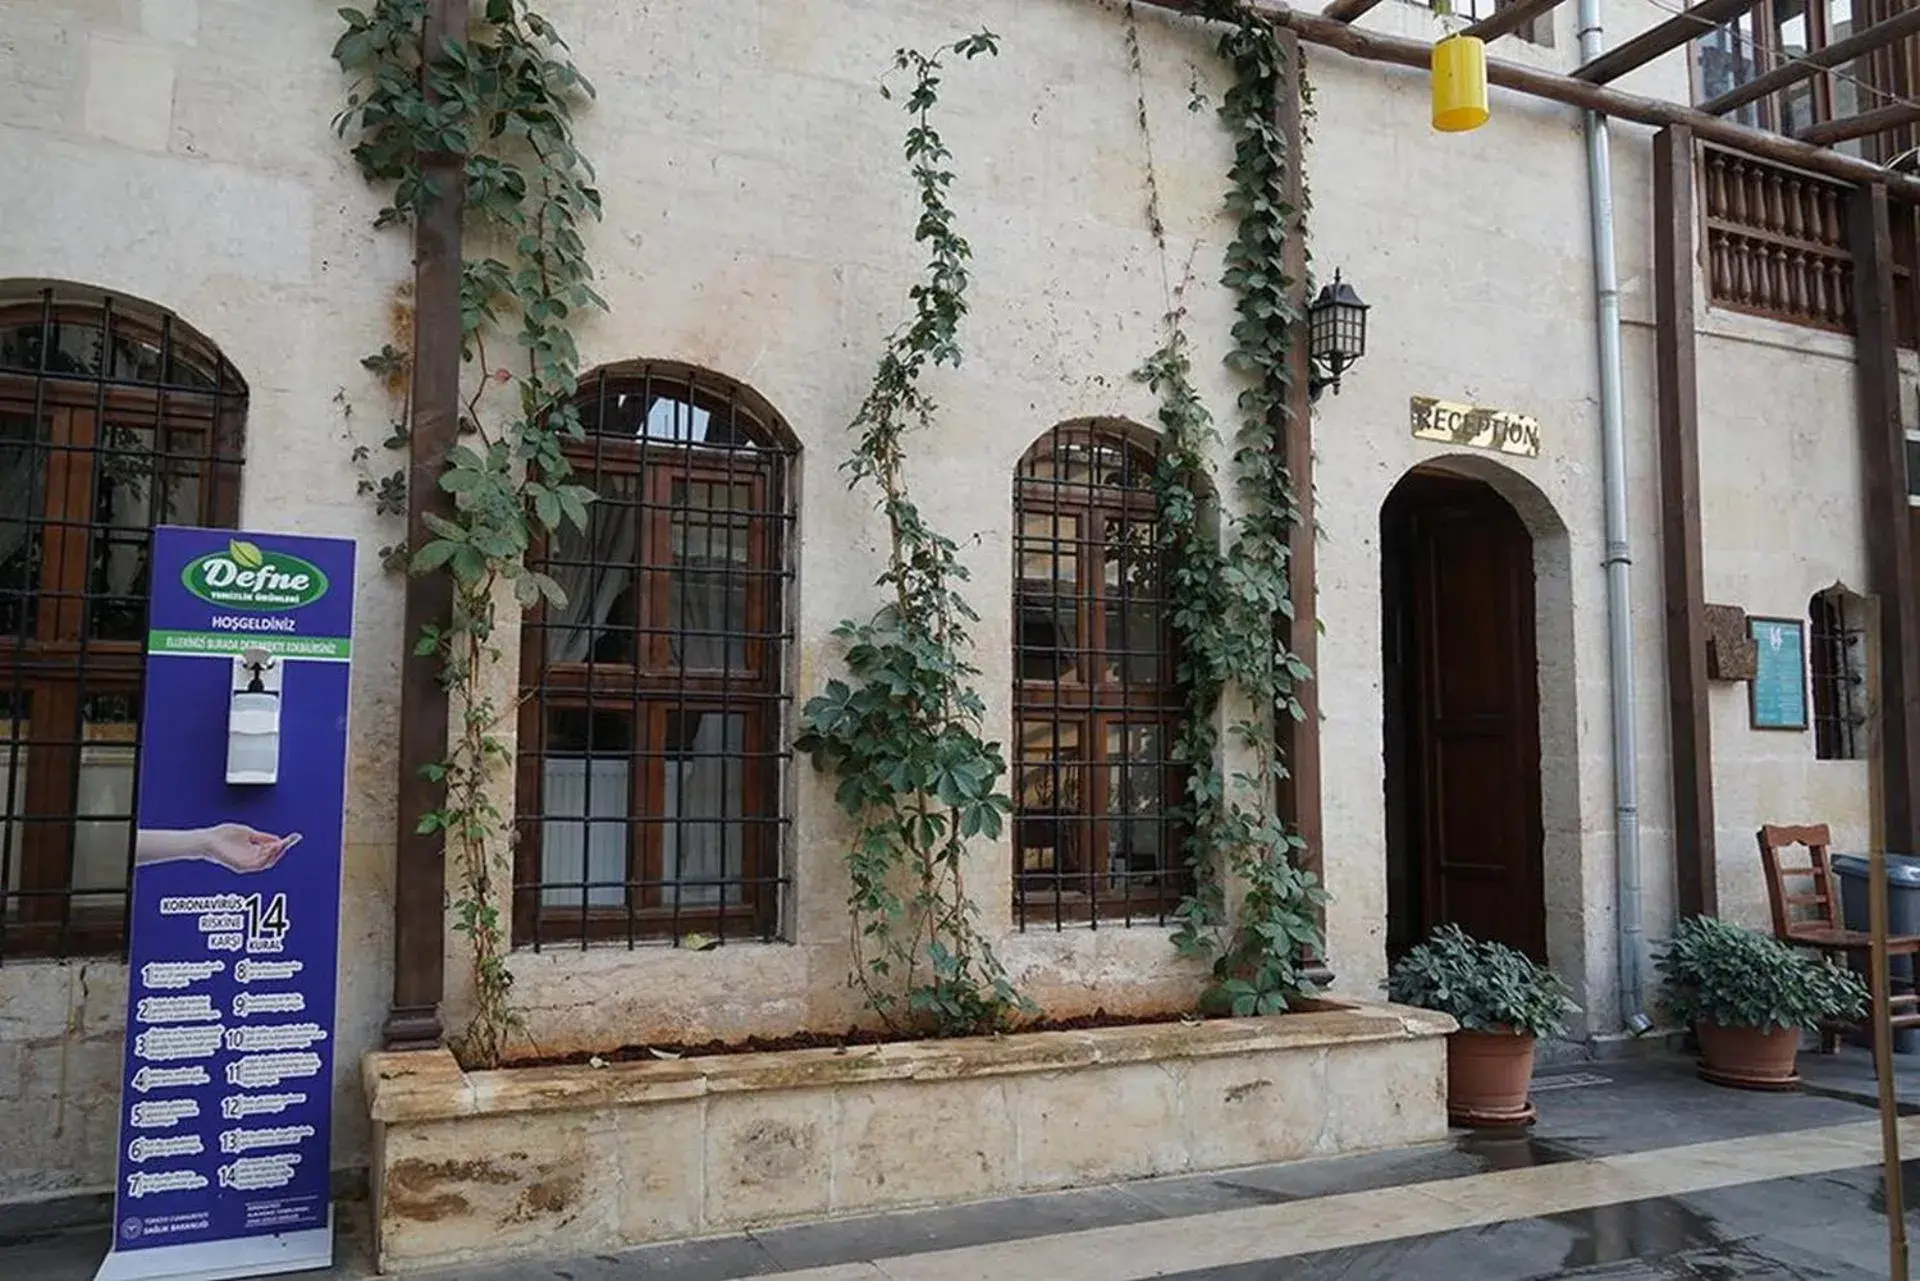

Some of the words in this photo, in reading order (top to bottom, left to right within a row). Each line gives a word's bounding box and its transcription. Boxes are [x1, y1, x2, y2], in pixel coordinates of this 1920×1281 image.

[1416, 404, 1538, 449] RECEPTION
[202, 557, 311, 592] Defne
[212, 615, 296, 632] HOŞGELDİNİZ
[162, 895, 243, 911] KORONAVİRÜS
[201, 915, 242, 930] RİSKİNE
[245, 895, 287, 938] 14
[210, 934, 241, 950] KARŞI
[249, 938, 282, 950] KURAL
[237, 963, 246, 980] 8
[139, 1002, 149, 1019] 2
[235, 996, 245, 1014] 9
[138, 1036, 146, 1054] 3
[229, 1031, 244, 1048] 10
[135, 1070, 144, 1087] 4
[134, 1107, 143, 1124] 5
[224, 1099, 238, 1116] 12
[132, 1140, 141, 1158] 6
[223, 1133, 237, 1150] 13
[221, 1166, 236, 1183] 14
[130, 1176, 140, 1193] 7
